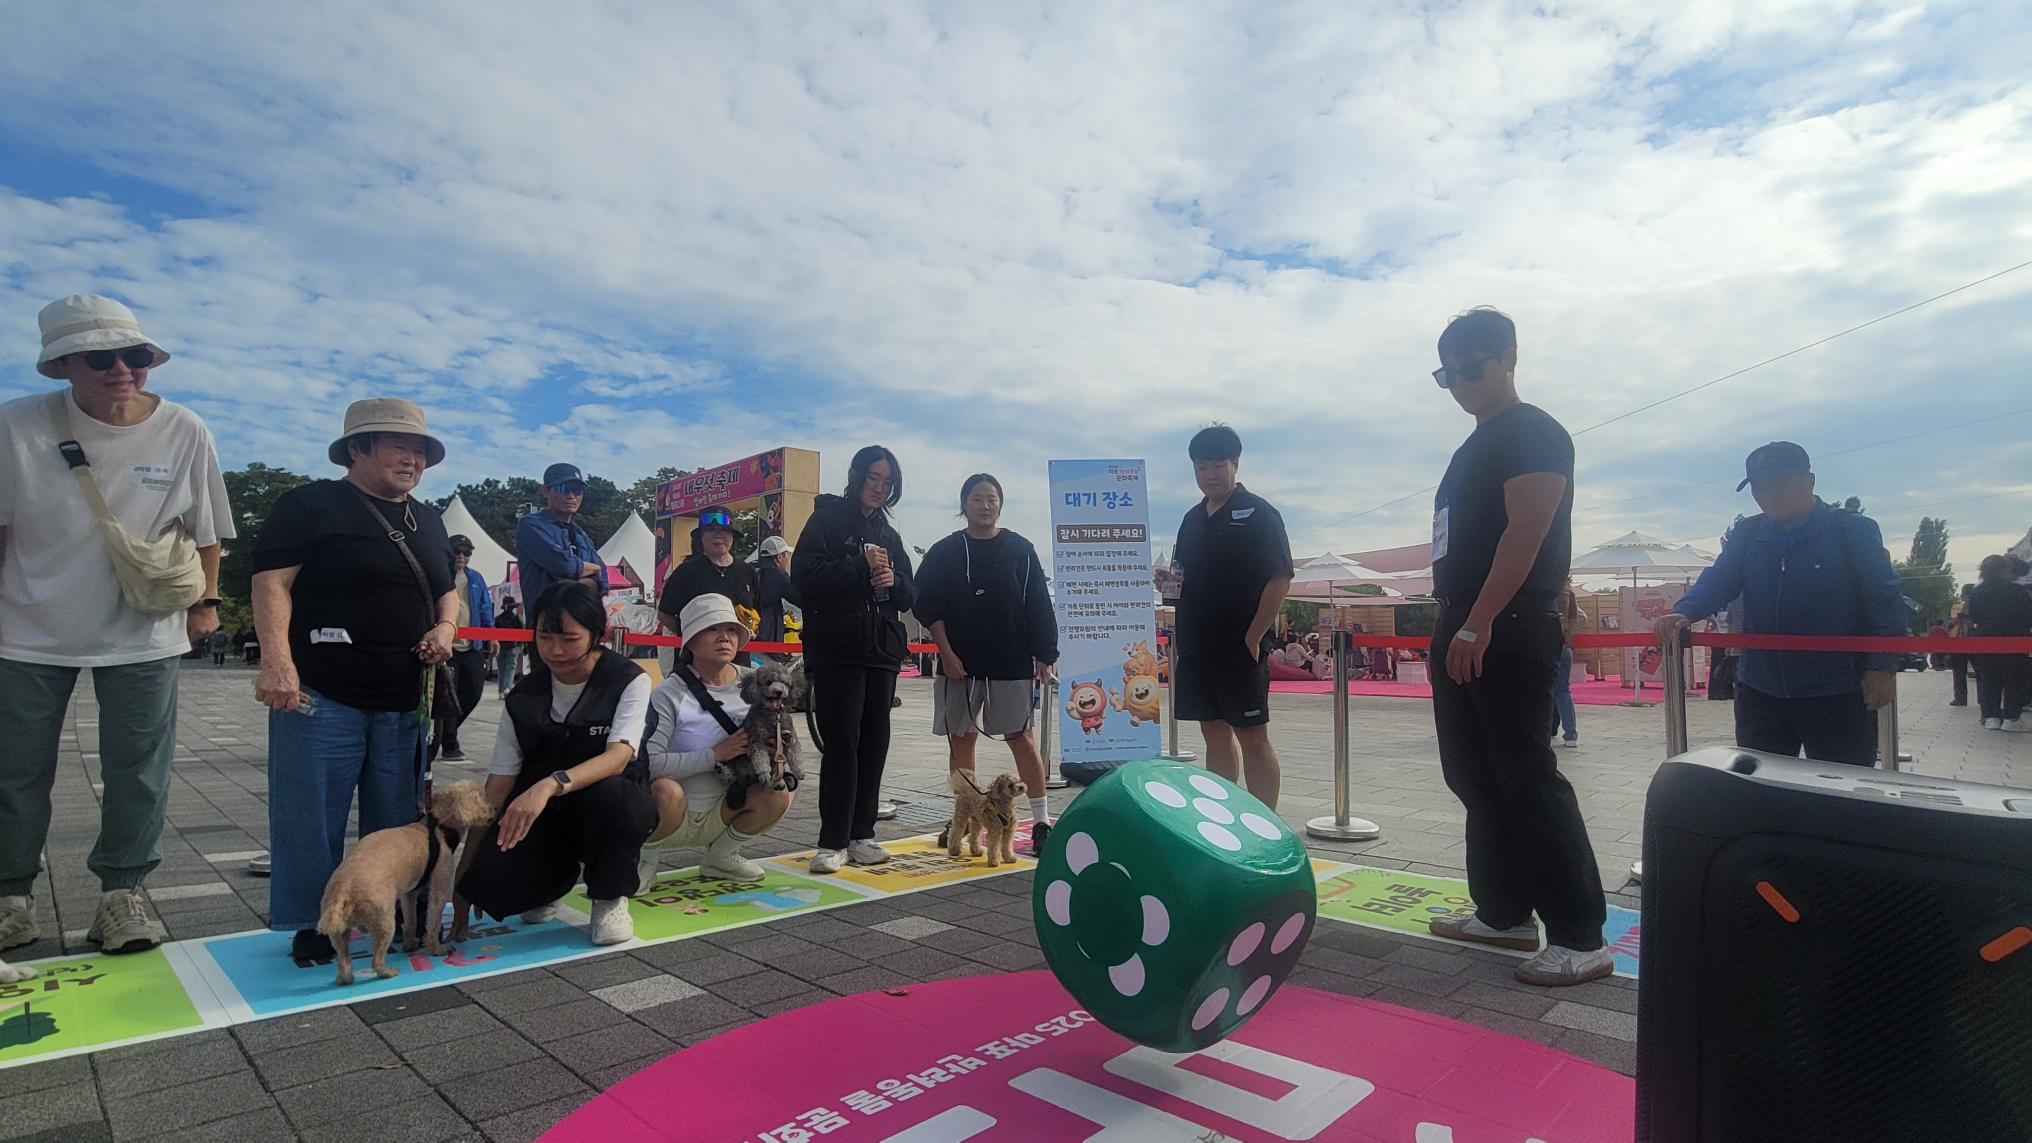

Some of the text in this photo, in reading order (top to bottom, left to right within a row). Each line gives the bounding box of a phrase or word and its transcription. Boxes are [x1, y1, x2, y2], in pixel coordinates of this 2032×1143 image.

[684, 466, 740, 497] 새우젓 축제
[1065, 491, 1134, 509] 대기 장소
[1060, 528, 1143, 540] 잠시 기다려 주세요!
[589, 725, 611, 736] STA
[635, 881, 766, 908] 댕댕이
[1350, 883, 1443, 916] 놀이터
[743, 1009, 1097, 1143] 025 마포 반려동물 문화
